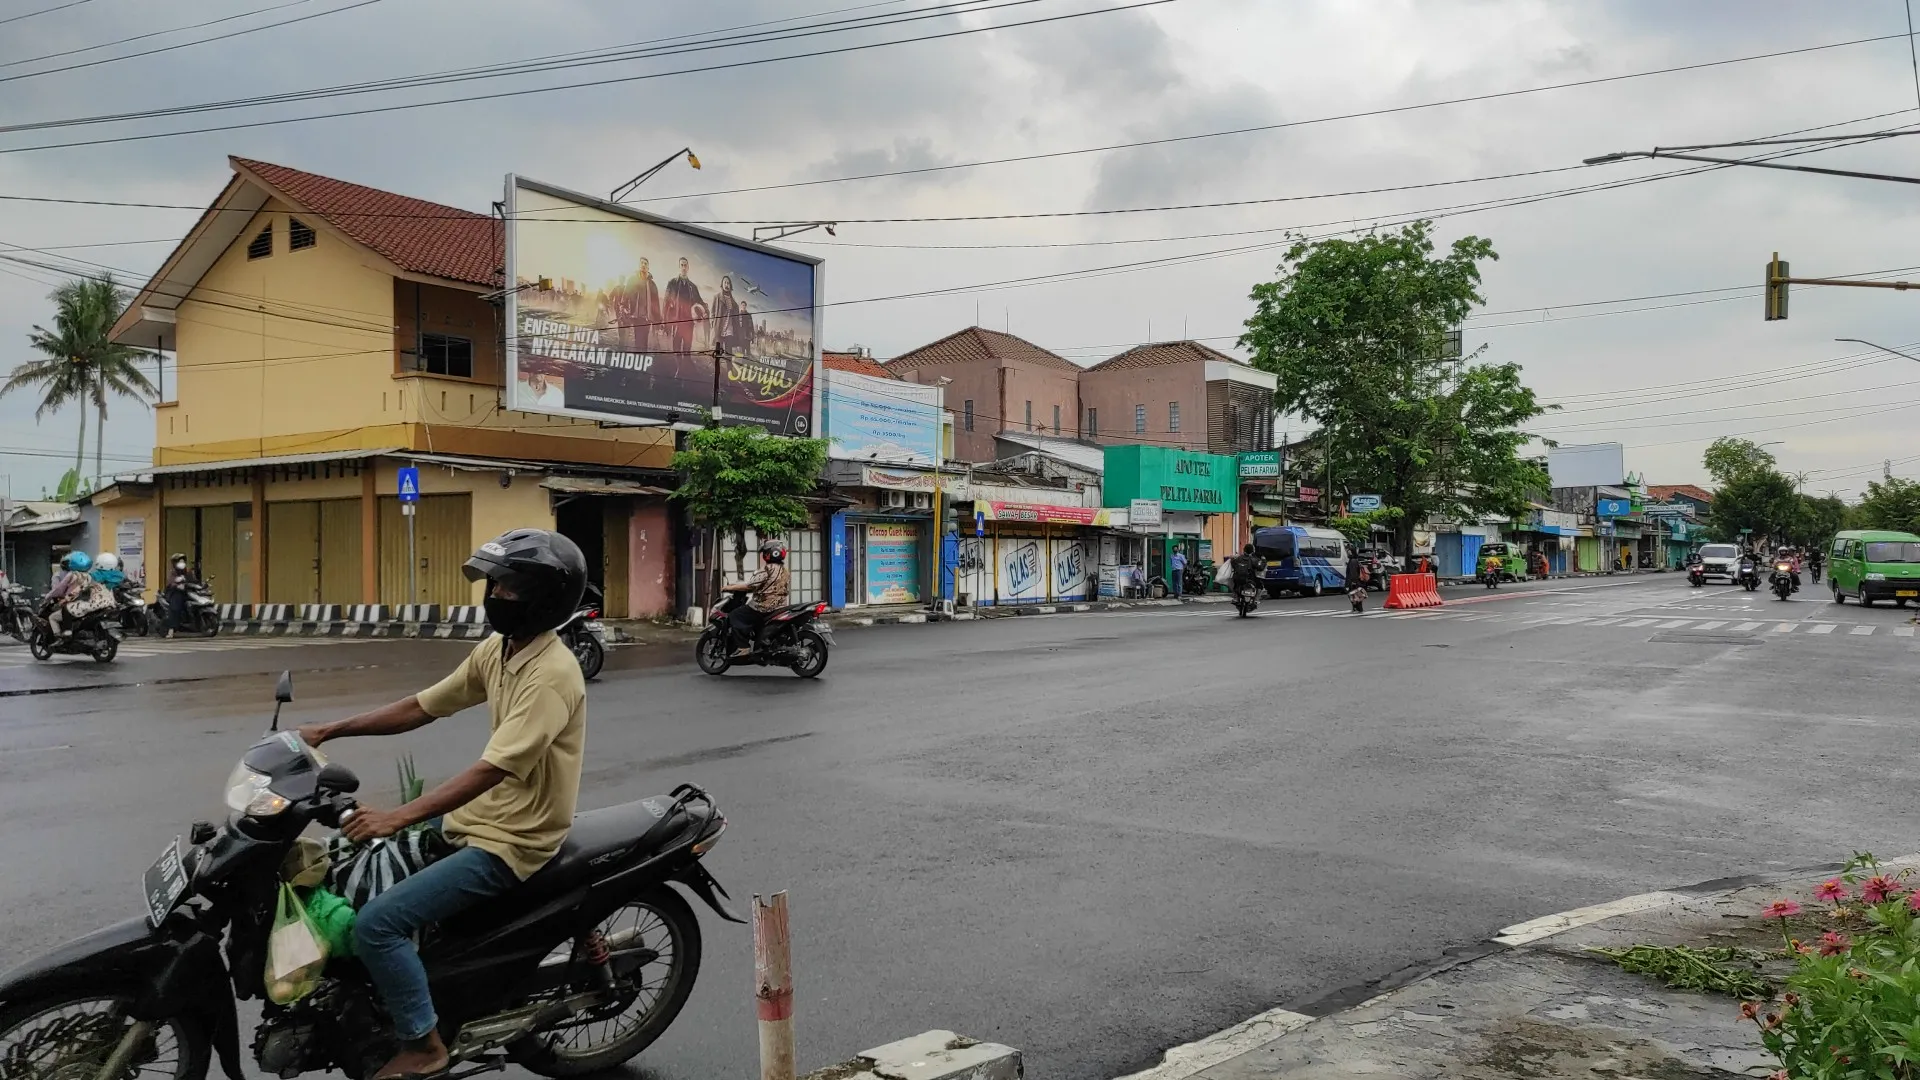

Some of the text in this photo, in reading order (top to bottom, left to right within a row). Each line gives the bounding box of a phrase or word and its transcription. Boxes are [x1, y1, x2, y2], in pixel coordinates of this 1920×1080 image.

[524, 317, 599, 345] ENERGI KITA
[531, 337, 653, 372] NYALAKAN HIDUP
[728, 361, 792, 395] Surya
[1174, 459, 1211, 476] APOTEK
[1240, 466, 1277, 474] PELITA FARMA
[1160, 485, 1222, 505] PELITA FARMA
[998, 509, 1019, 519] SAWAH
[1020, 510, 1038, 520] BESAR
[869, 526, 887, 537] Cilacap
[888, 526, 902, 537] Guest
[1009, 553, 1029, 588] CLAS
[1059, 552, 1076, 586] CLAS
